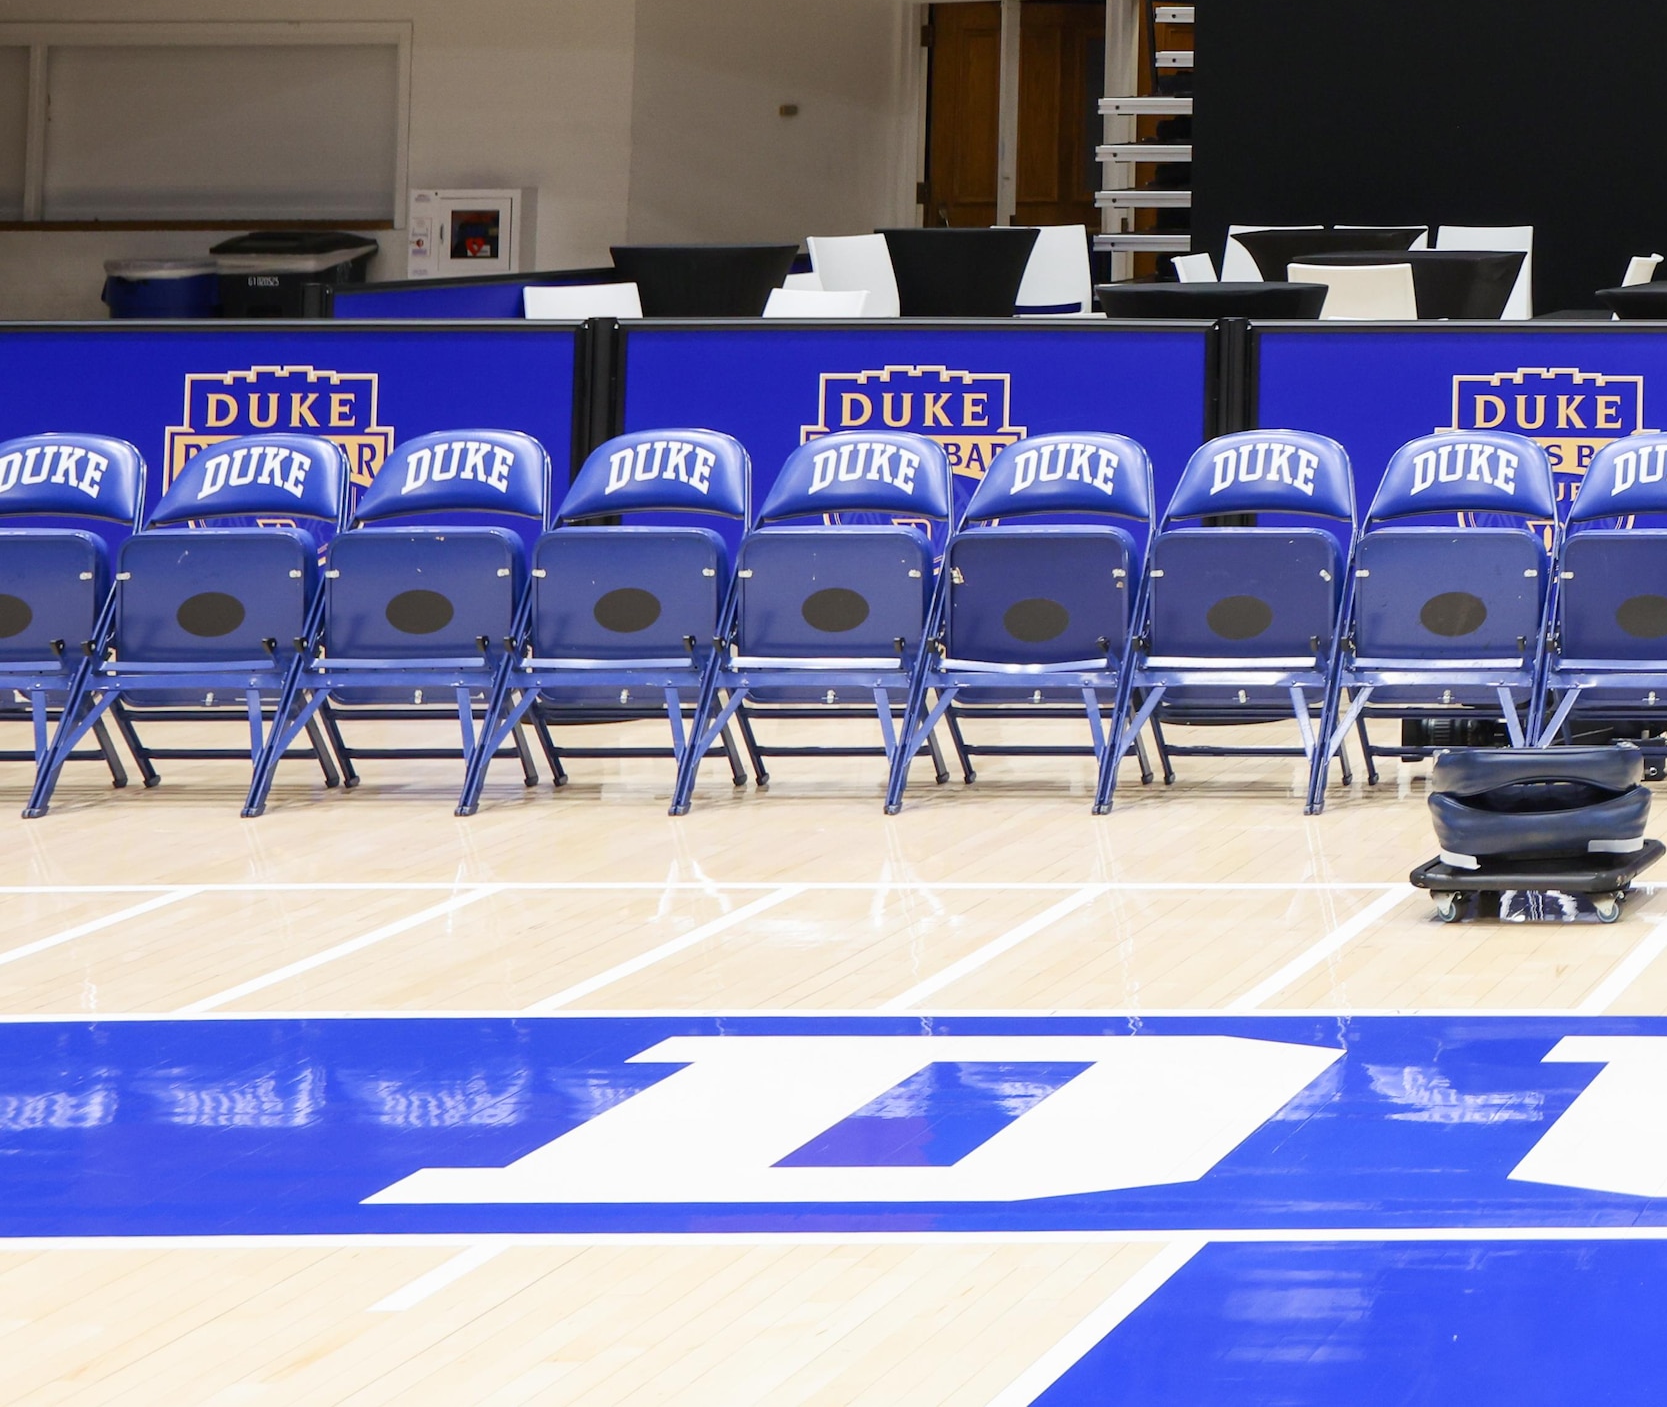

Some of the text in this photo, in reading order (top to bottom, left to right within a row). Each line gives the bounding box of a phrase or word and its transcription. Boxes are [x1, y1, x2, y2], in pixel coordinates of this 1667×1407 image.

[207, 393, 356, 428] DUKE
[840, 393, 989, 427] DUKE
[1473, 395, 1623, 429] DUKE
[0, 446, 109, 498] DUKE
[197, 446, 312, 500] DUKE
[401, 441, 515, 495] DUKE
[605, 440, 717, 495] DUKE
[808, 442, 921, 495] DUKE
[1010, 443, 1120, 495] DUKE
[1210, 442, 1319, 496] DUKE
[1410, 443, 1519, 496] DUKE
